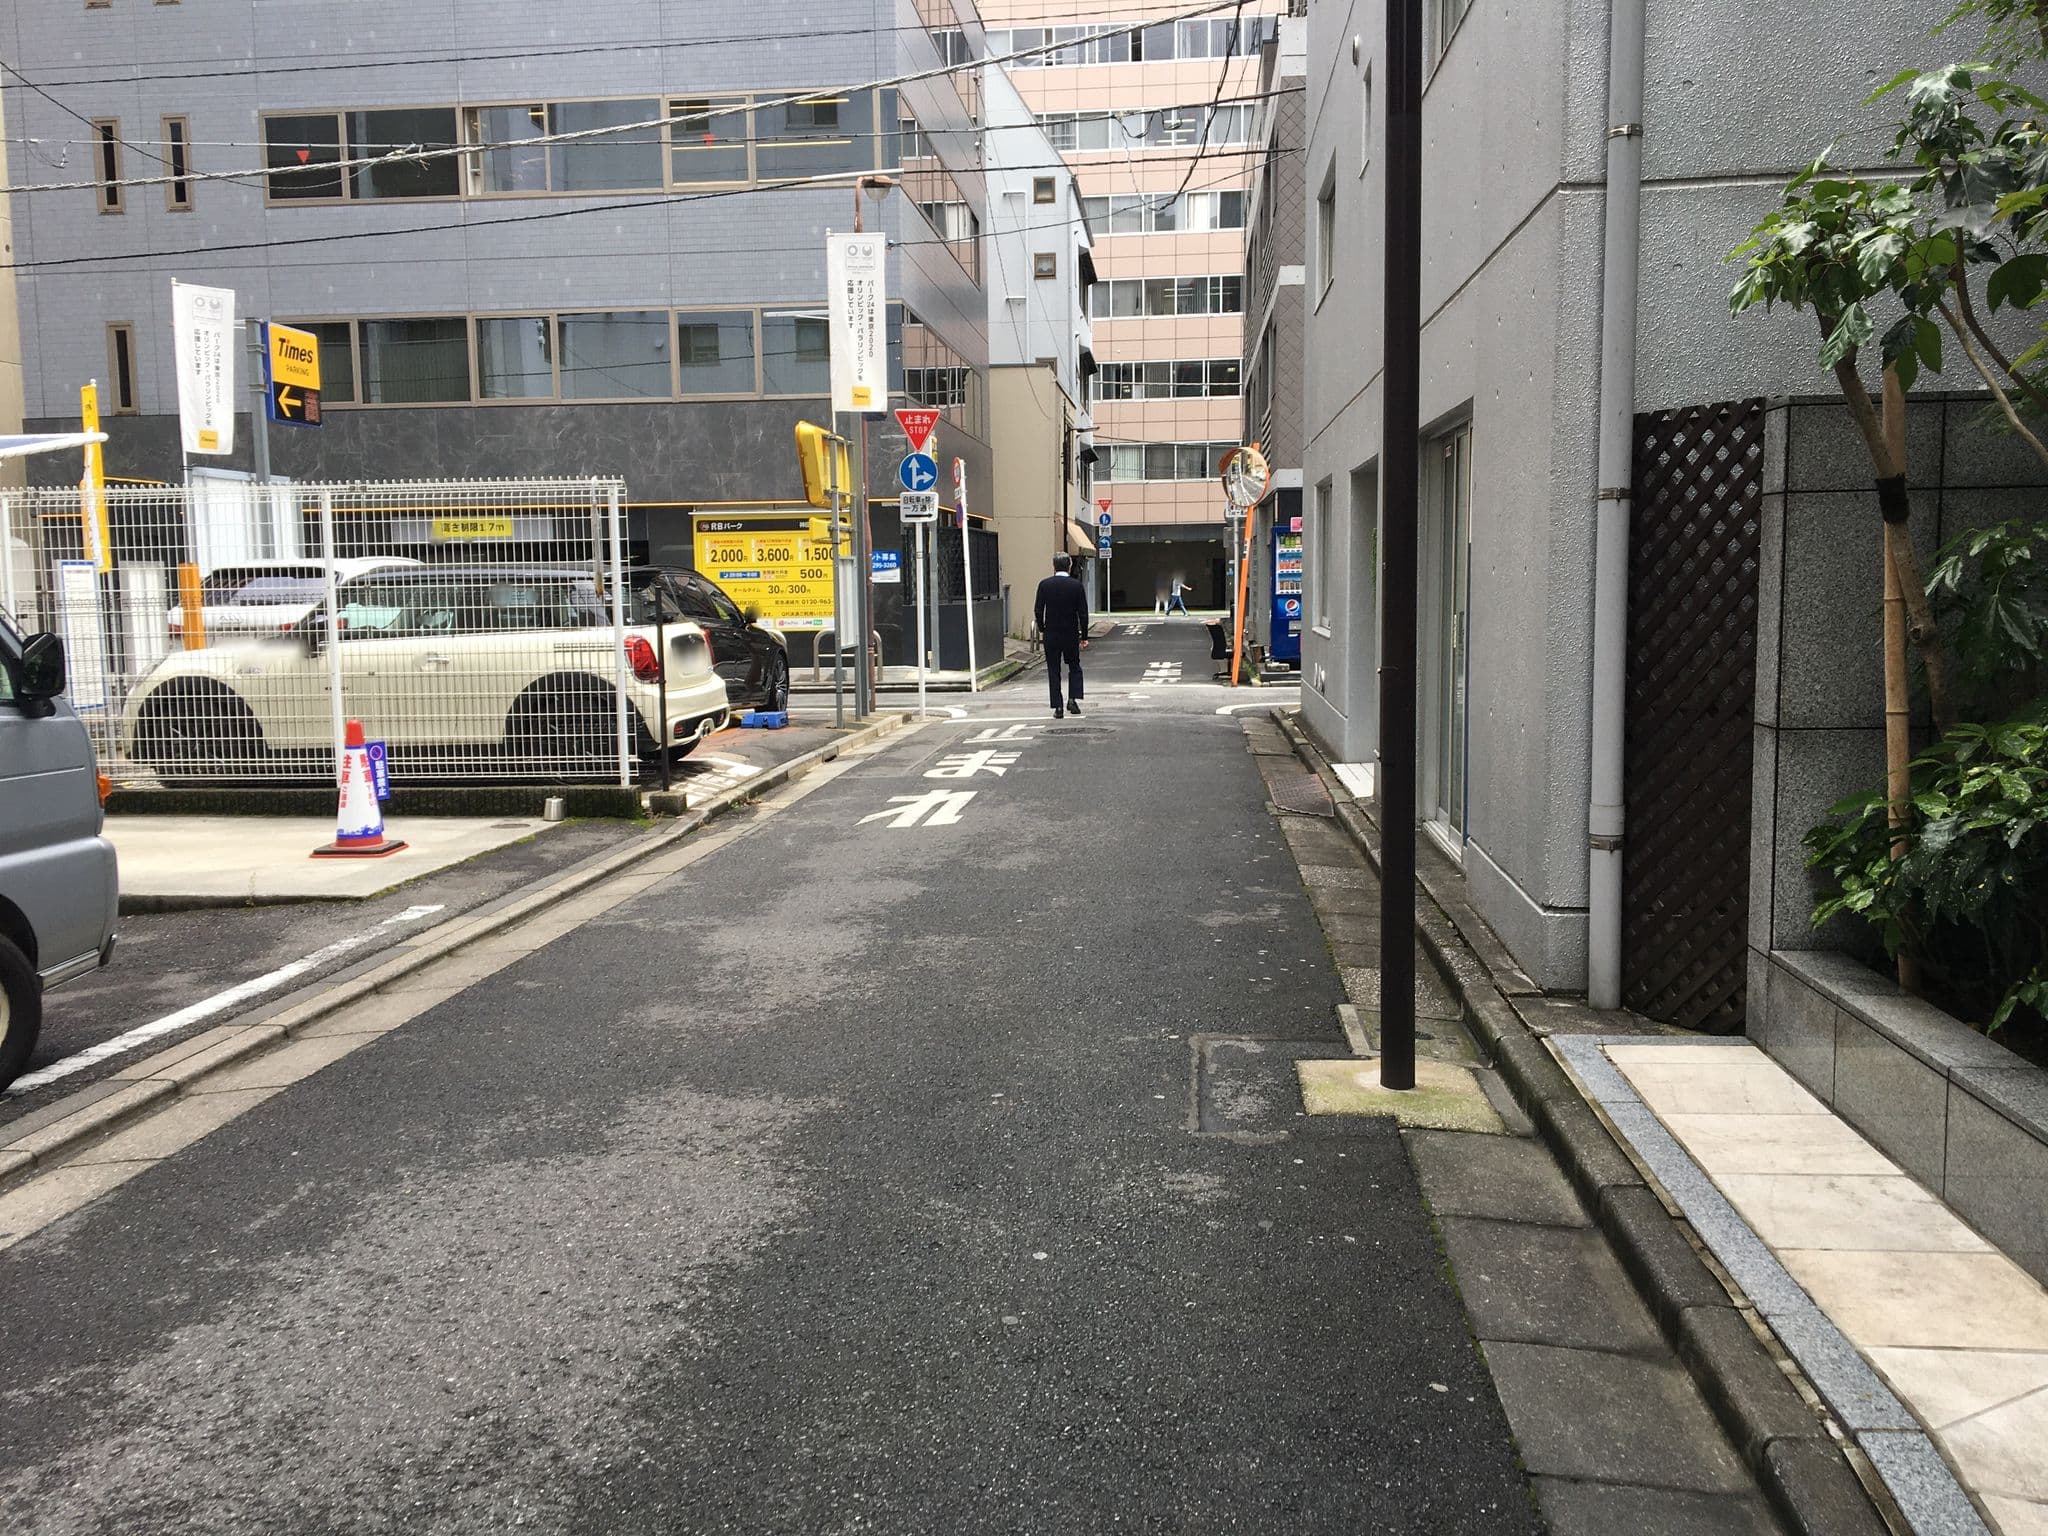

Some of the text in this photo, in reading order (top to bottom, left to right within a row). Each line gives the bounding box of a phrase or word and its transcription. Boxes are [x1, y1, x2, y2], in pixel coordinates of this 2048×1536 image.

[278, 337, 314, 364] Times
[904, 415, 931, 425] 止まれ
[909, 426, 928, 434] STOP
[710, 522, 743, 531] RBパーク
[854, 723, 1046, 828] 止まれ
